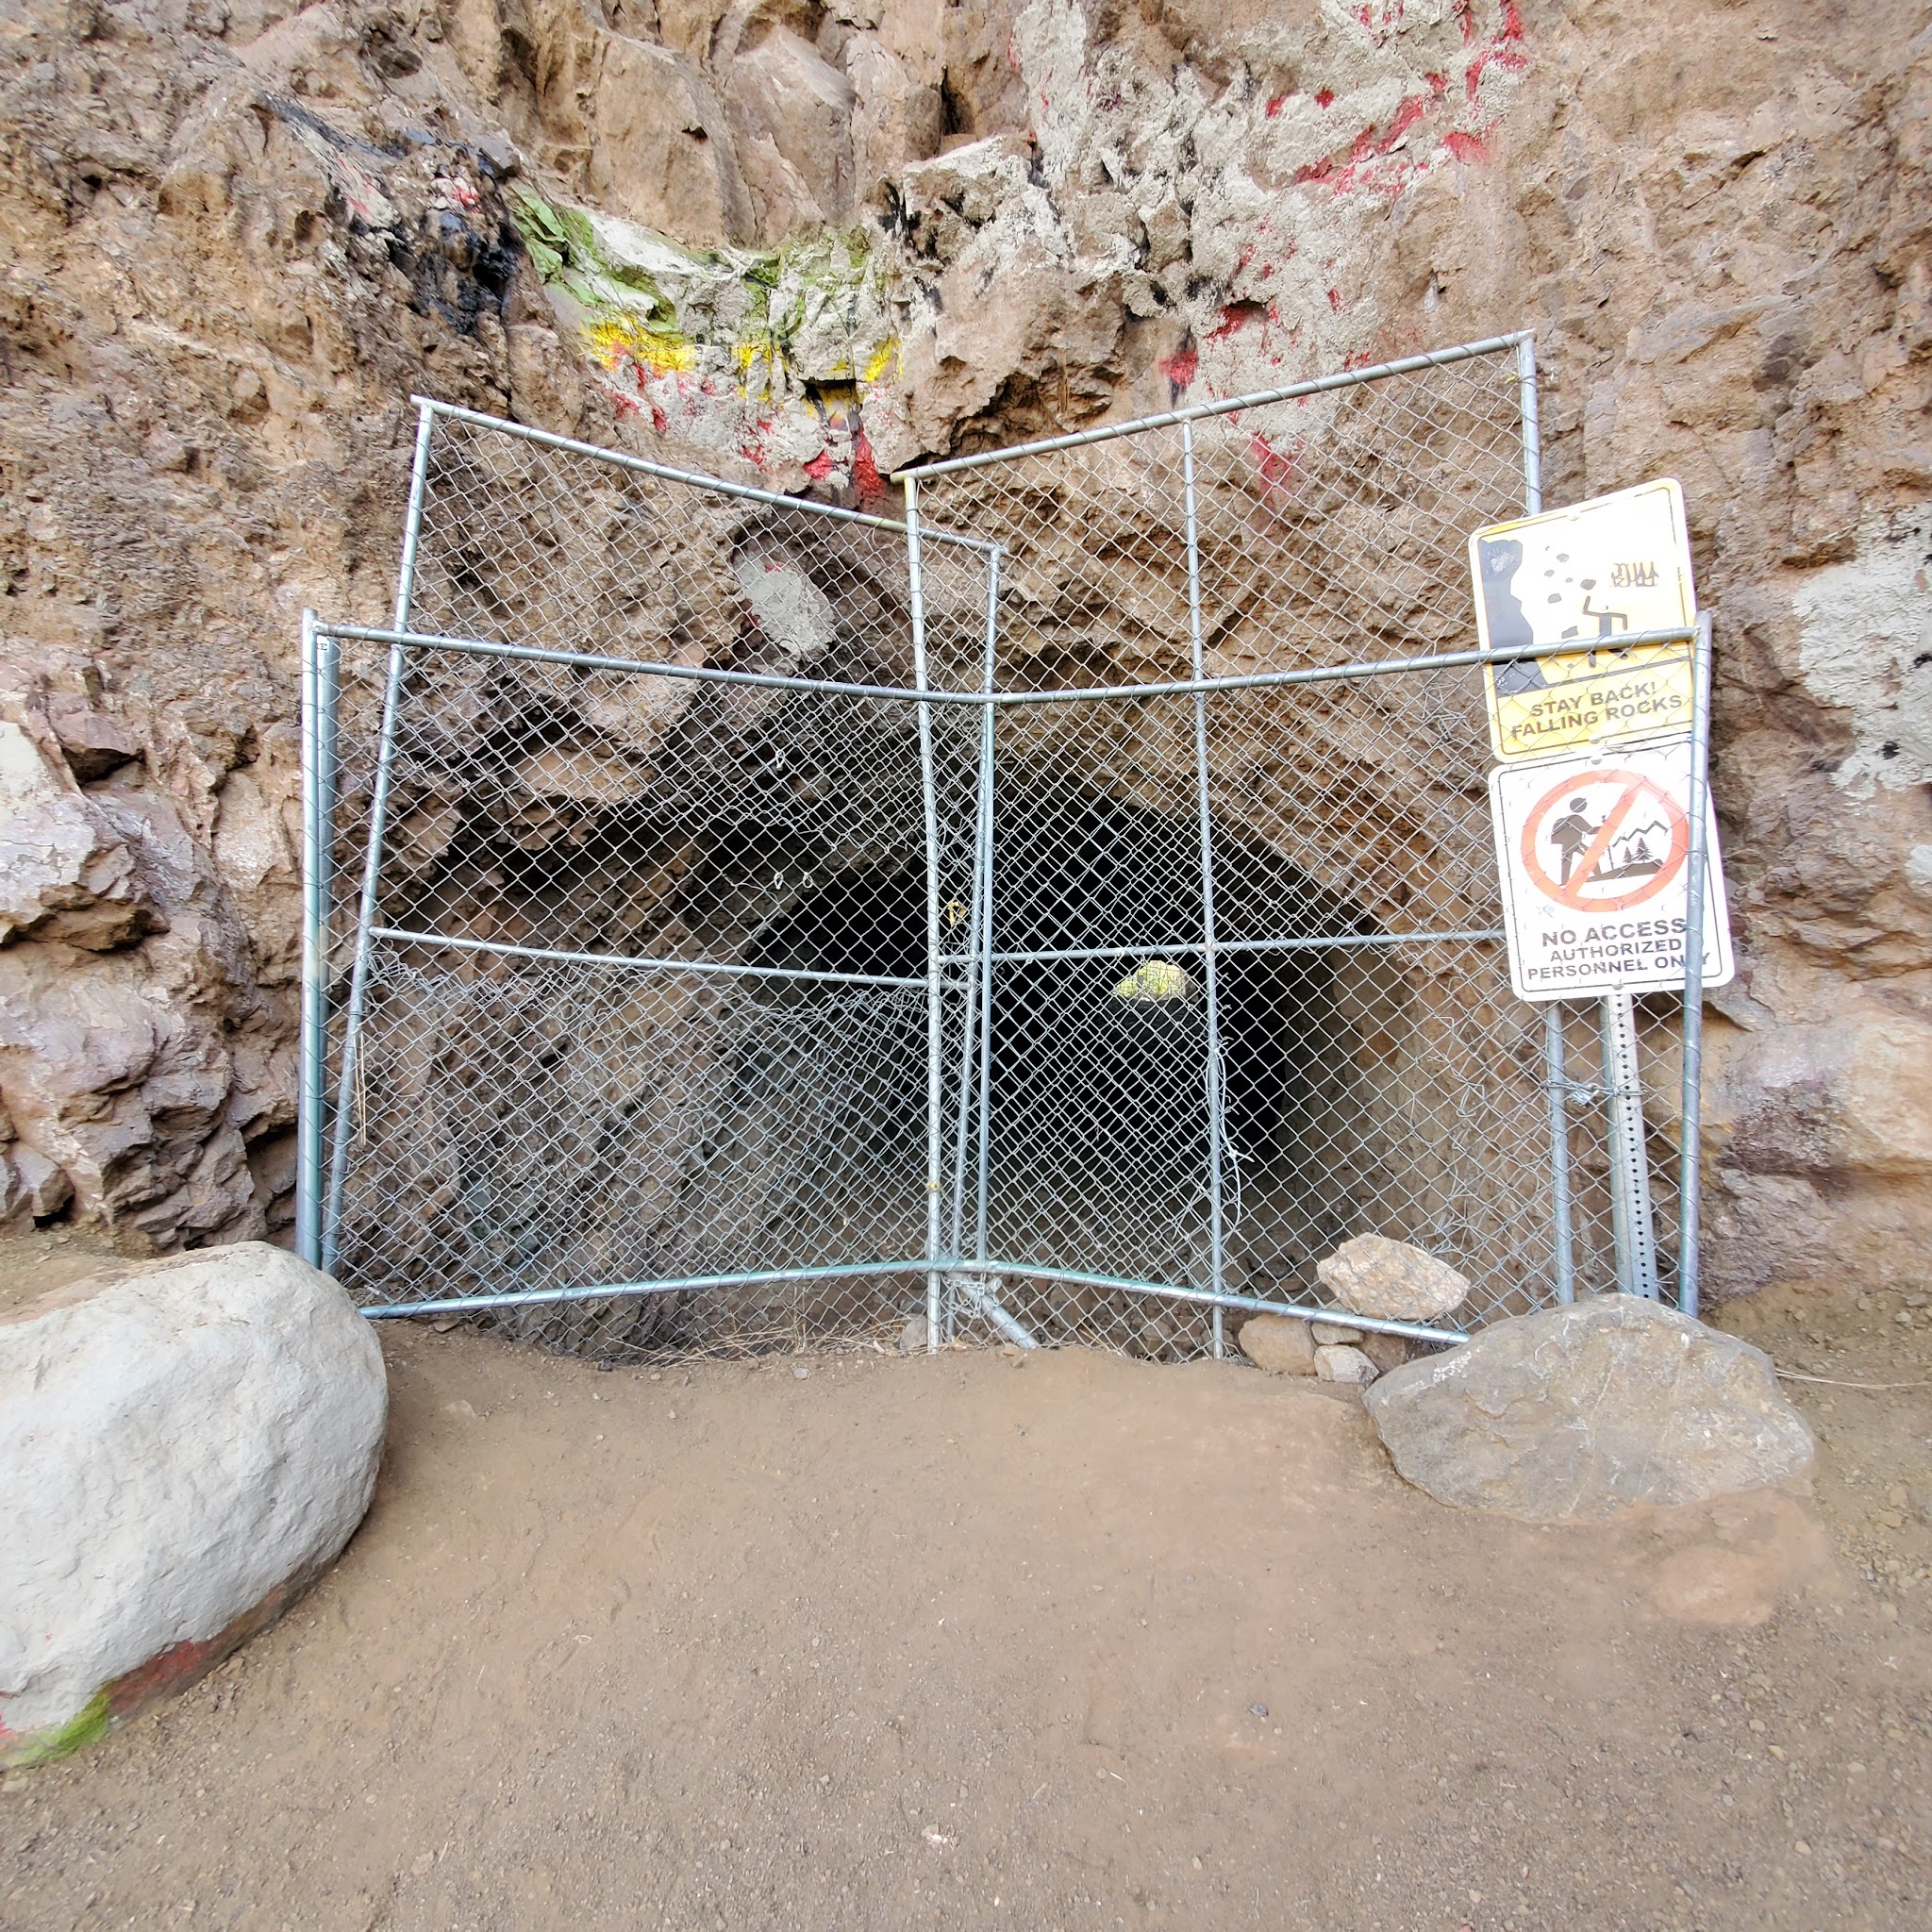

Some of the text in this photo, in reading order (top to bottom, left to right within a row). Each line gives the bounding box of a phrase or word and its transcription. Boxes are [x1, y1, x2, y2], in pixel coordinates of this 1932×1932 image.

[1530, 681, 1657, 717] STAY BACK!
[1511, 694, 1683, 740] FALLING ROCKS
[1541, 918, 1687, 947] NO ACCESS
[1550, 938, 1682, 962] AUTHORIZED
[1528, 952, 1710, 980] PERSONNEL ONY
